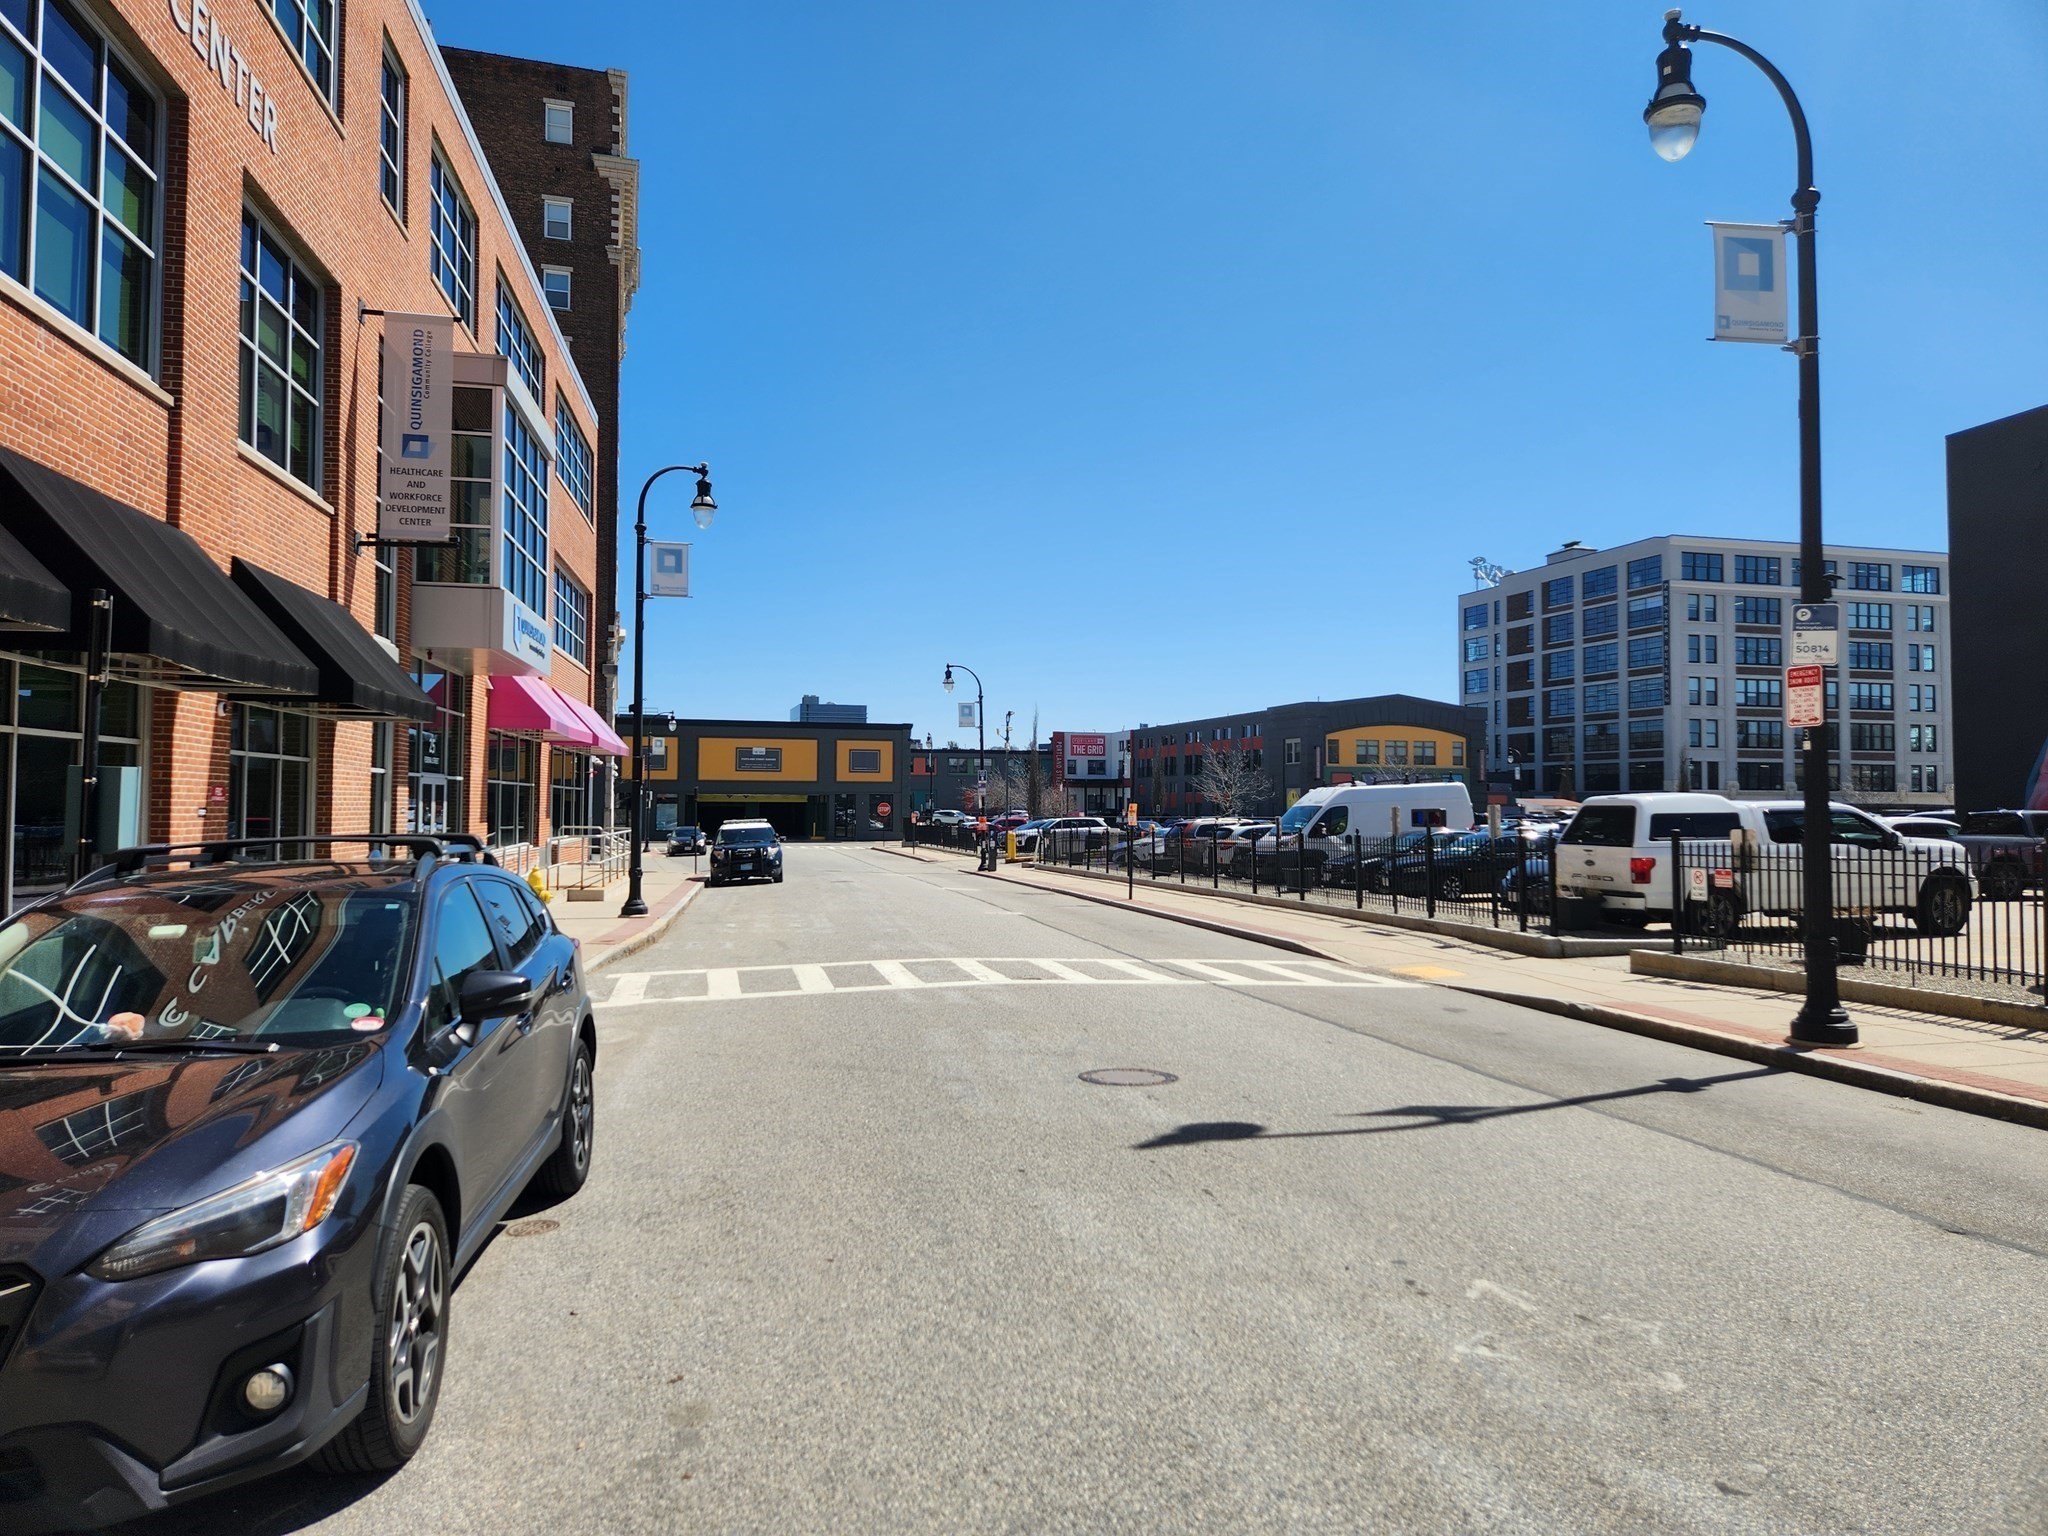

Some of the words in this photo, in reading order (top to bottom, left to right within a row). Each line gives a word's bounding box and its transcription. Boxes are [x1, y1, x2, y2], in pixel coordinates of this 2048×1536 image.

[168, 0, 278, 156] CENTER
[425, 330, 433, 357] College
[410, 329, 424, 430] QUINSIGAMOND
[424, 360, 432, 399] Community
[390, 467, 444, 477] HEALTHCARE
[406, 480, 426, 489] AND
[389, 491, 443, 502] WORKFORCE
[385, 504, 446, 514] DEVELOPMENT
[399, 516, 432, 526] CENTER
[1795, 645, 1829, 653] 50814
[1790, 669, 1818, 677] EMERGENCY
[1073, 745, 1086, 754] THE
[1088, 745, 1103, 754] GRID
[1571, 873, 1614, 882] F-150
